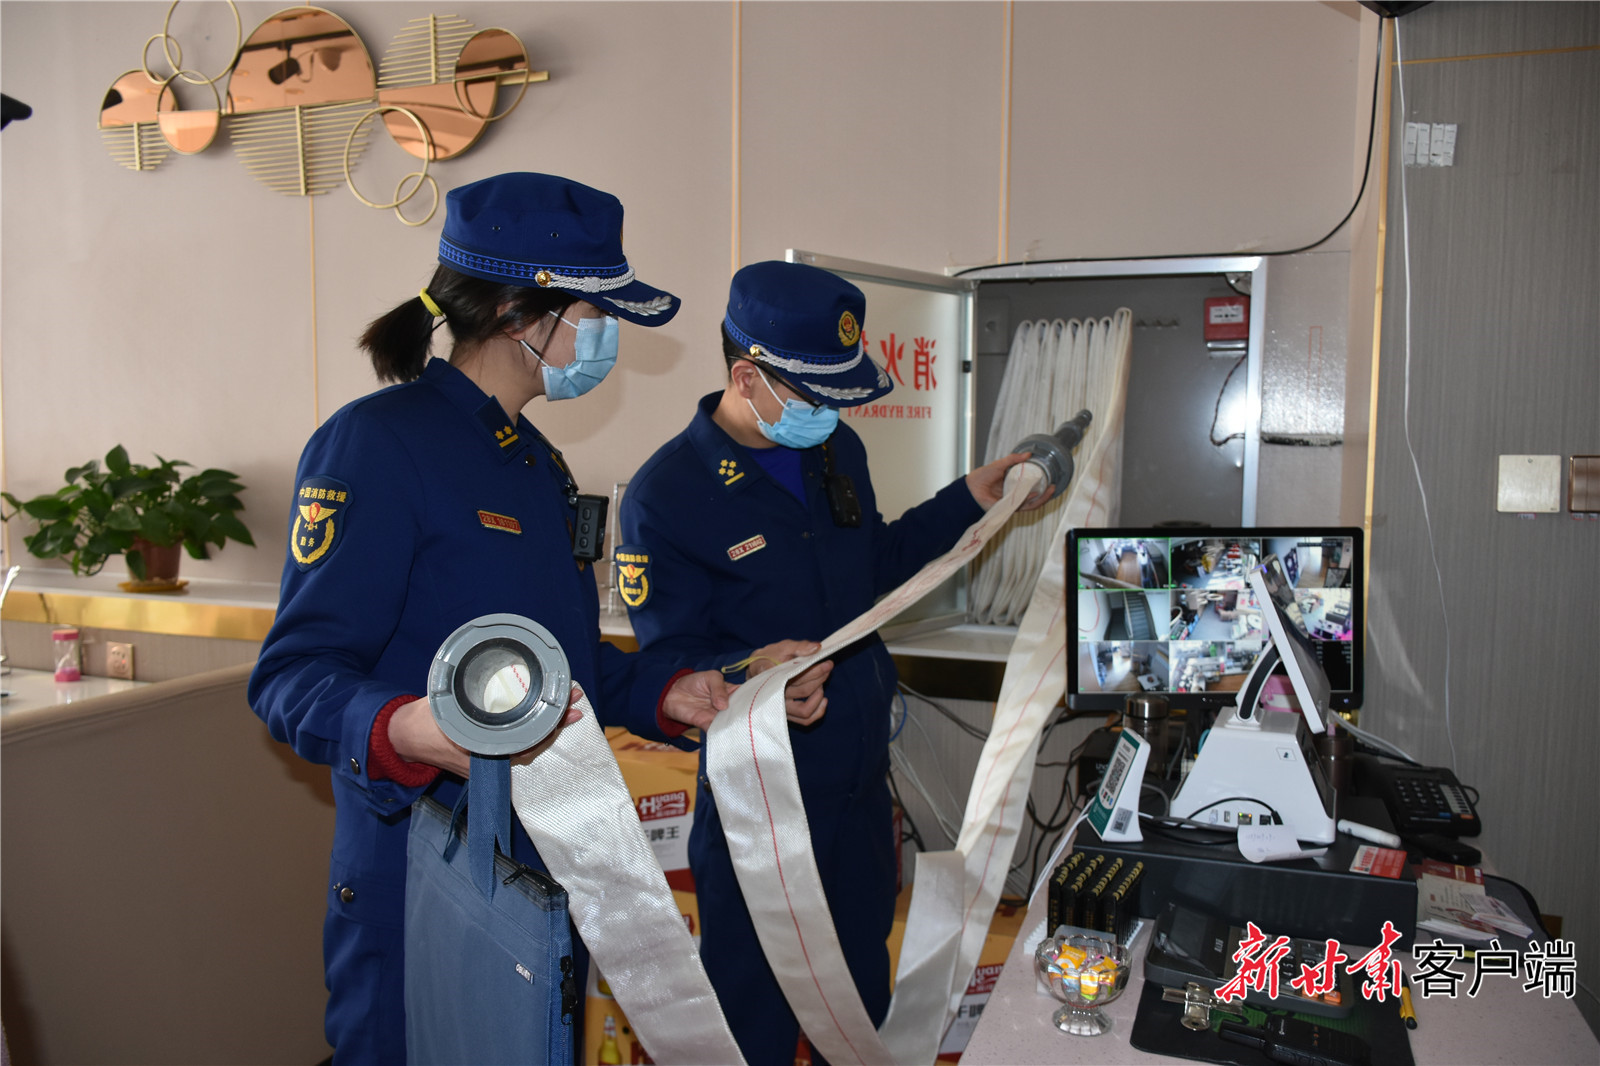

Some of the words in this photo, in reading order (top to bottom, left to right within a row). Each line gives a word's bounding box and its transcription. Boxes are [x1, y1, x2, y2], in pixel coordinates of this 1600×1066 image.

[299, 487, 347, 502] 中国消防救援
